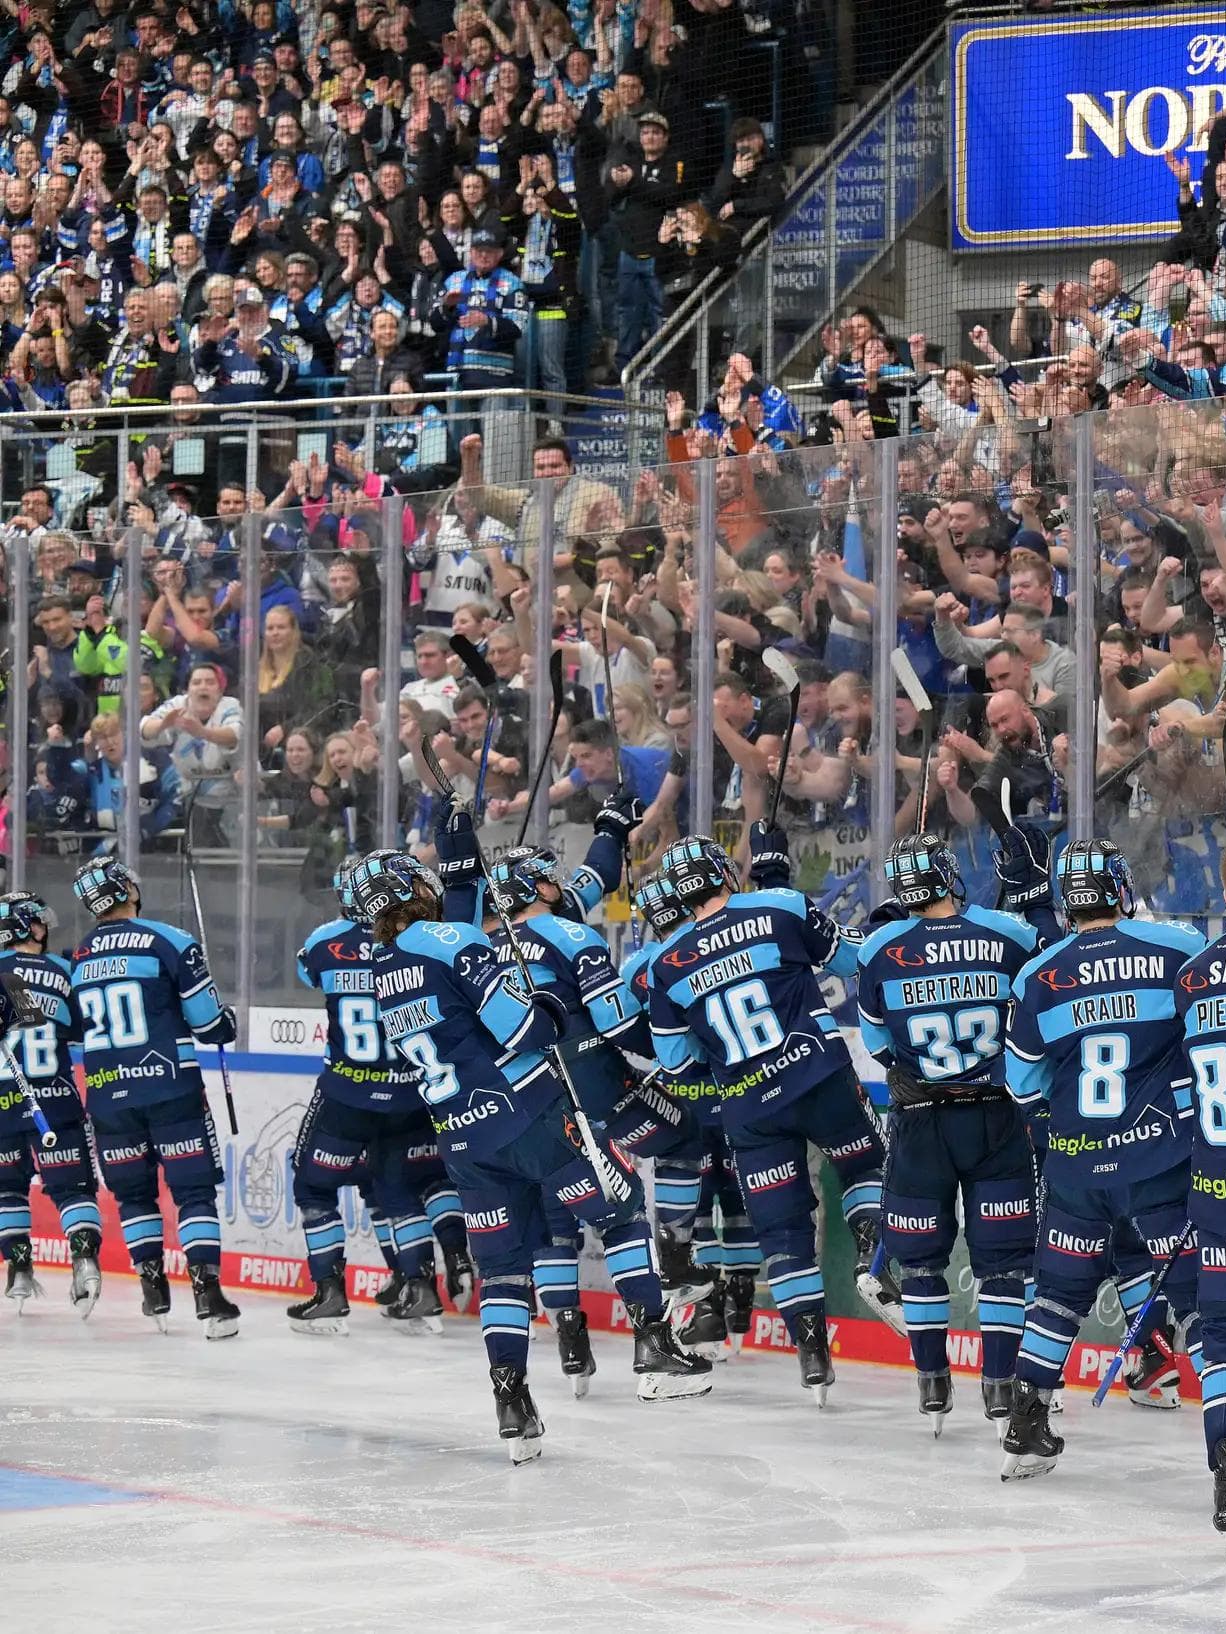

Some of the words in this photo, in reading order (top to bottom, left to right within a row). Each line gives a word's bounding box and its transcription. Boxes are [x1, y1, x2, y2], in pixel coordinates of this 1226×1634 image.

[91, 932, 155, 954] SATURN
[697, 915, 773, 956] SATURN
[925, 939, 1004, 966] SATURN
[82, 958, 128, 981] QUAAS
[376, 965, 425, 1000] SATURN
[688, 951, 754, 997] MCGINN
[1078, 956, 1164, 985] SATURN
[902, 973, 999, 1007] BERTRAND
[78, 980, 150, 1053] 20
[705, 978, 785, 1066] 16
[907, 1005, 1002, 1082] 33
[1078, 1032, 1131, 1119] 8
[312, 1148, 355, 1167] CINQUE
[746, 1160, 798, 1190] CINQUE
[887, 1213, 938, 1231] CINQUE
[980, 1199, 1031, 1217] CINQUE
[1048, 1228, 1105, 1253] CINQUE
